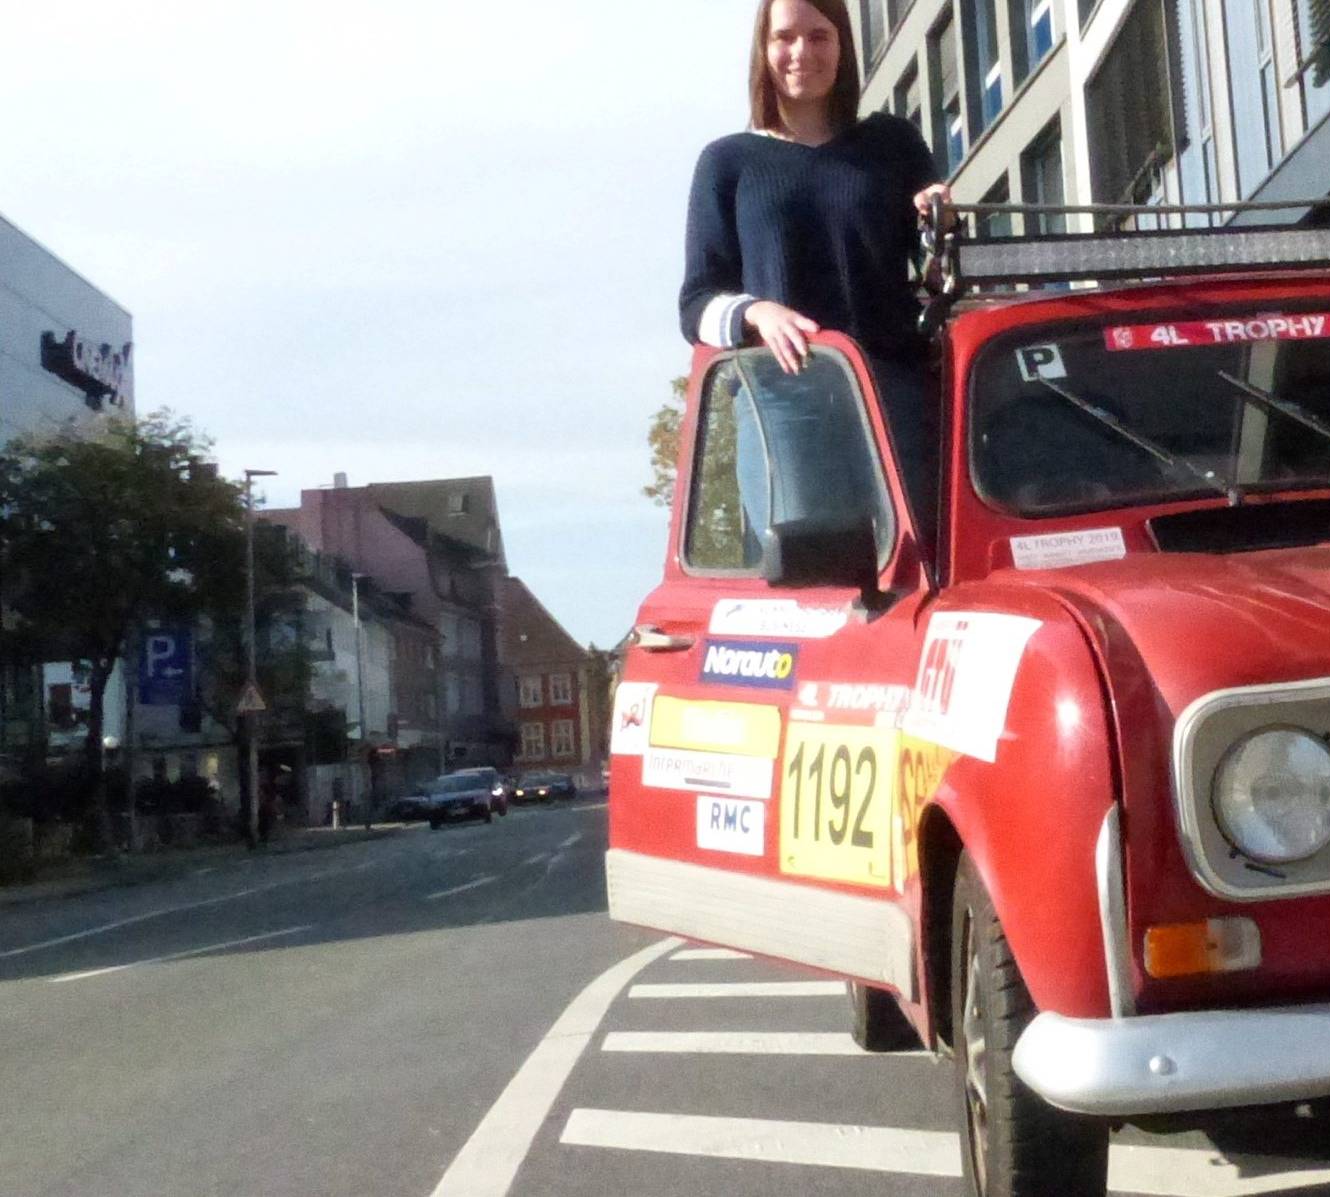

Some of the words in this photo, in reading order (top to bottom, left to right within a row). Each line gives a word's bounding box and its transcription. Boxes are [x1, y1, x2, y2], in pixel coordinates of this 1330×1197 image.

[1150, 328, 1189, 346] 4L
[1205, 316, 1325, 343] TROPHY
[1022, 348, 1055, 378] P
[146, 635, 176, 678] P
[703, 645, 793, 680] Norauto
[788, 740, 878, 848] 1192
[710, 802, 751, 834] RMC
